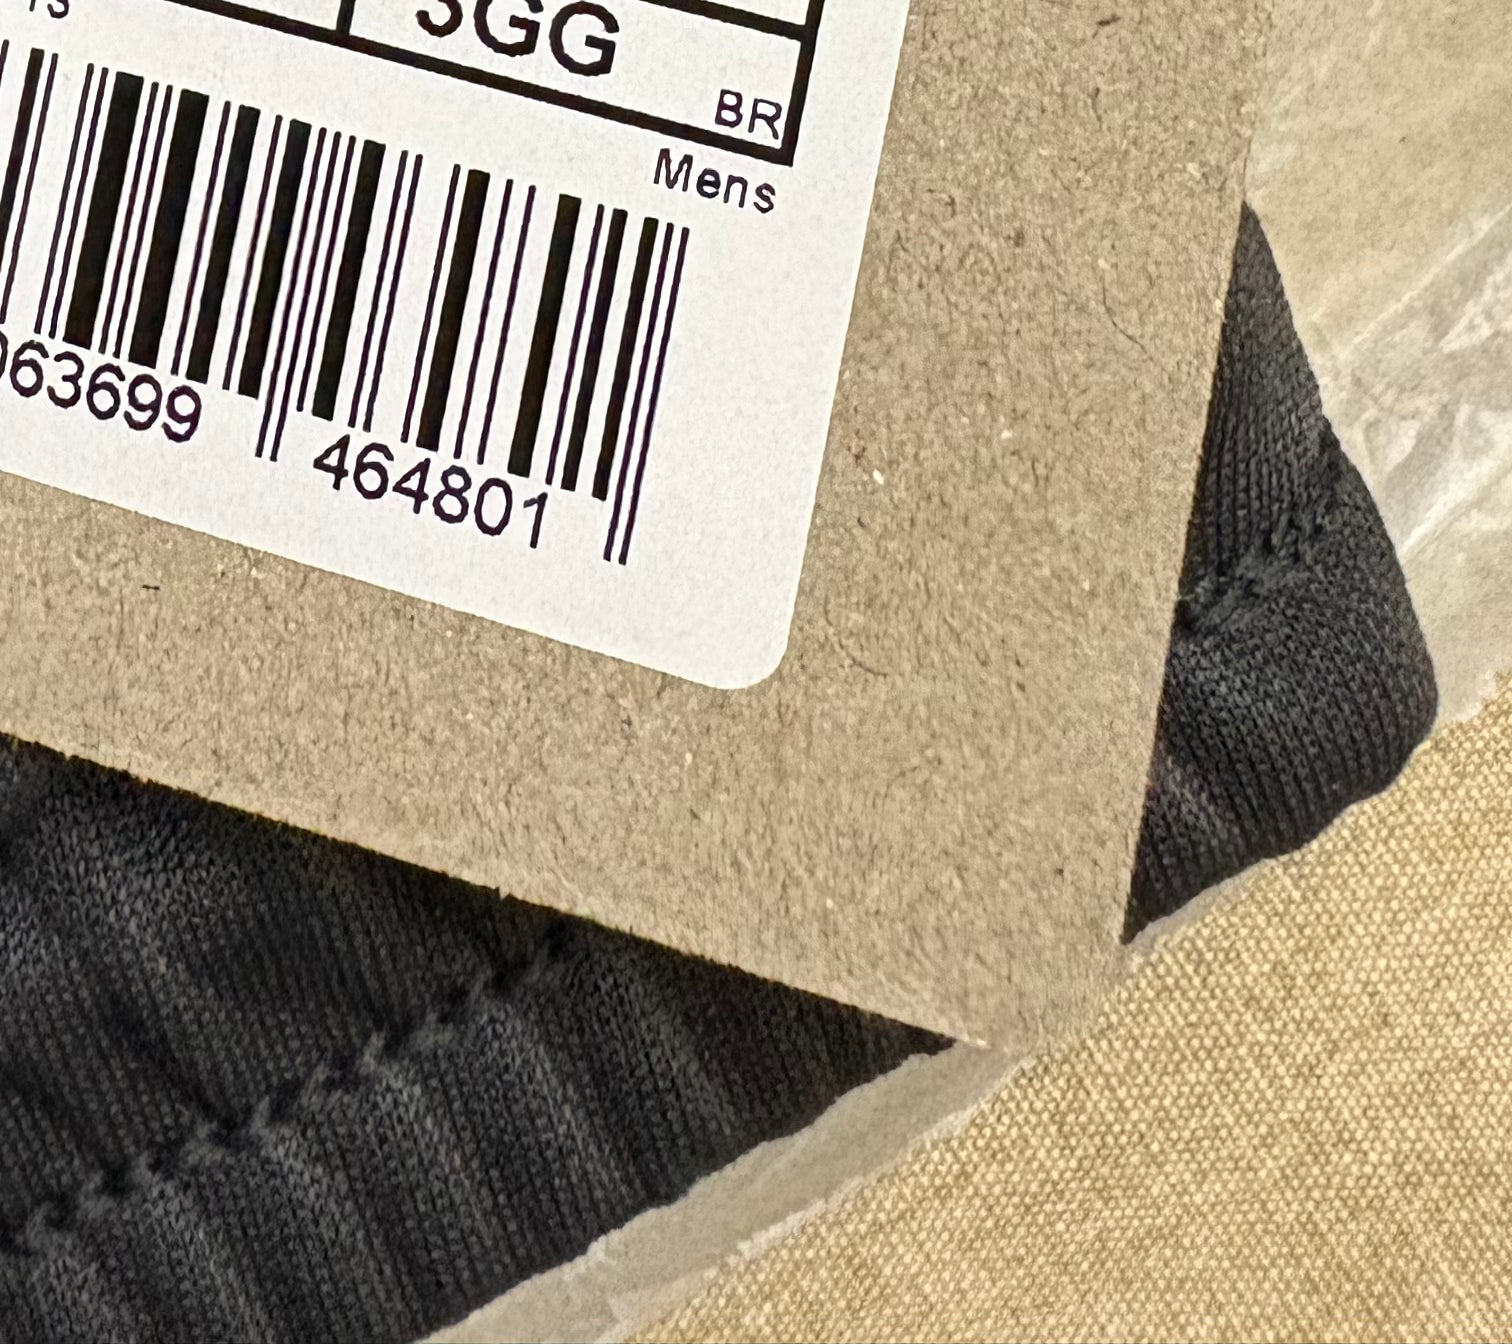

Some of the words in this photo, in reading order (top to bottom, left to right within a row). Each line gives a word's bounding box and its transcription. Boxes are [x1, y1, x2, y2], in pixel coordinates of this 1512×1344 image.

[714, 90, 783, 140] BR
[652, 148, 775, 214] Mens
[313, 434, 550, 550] 464801
